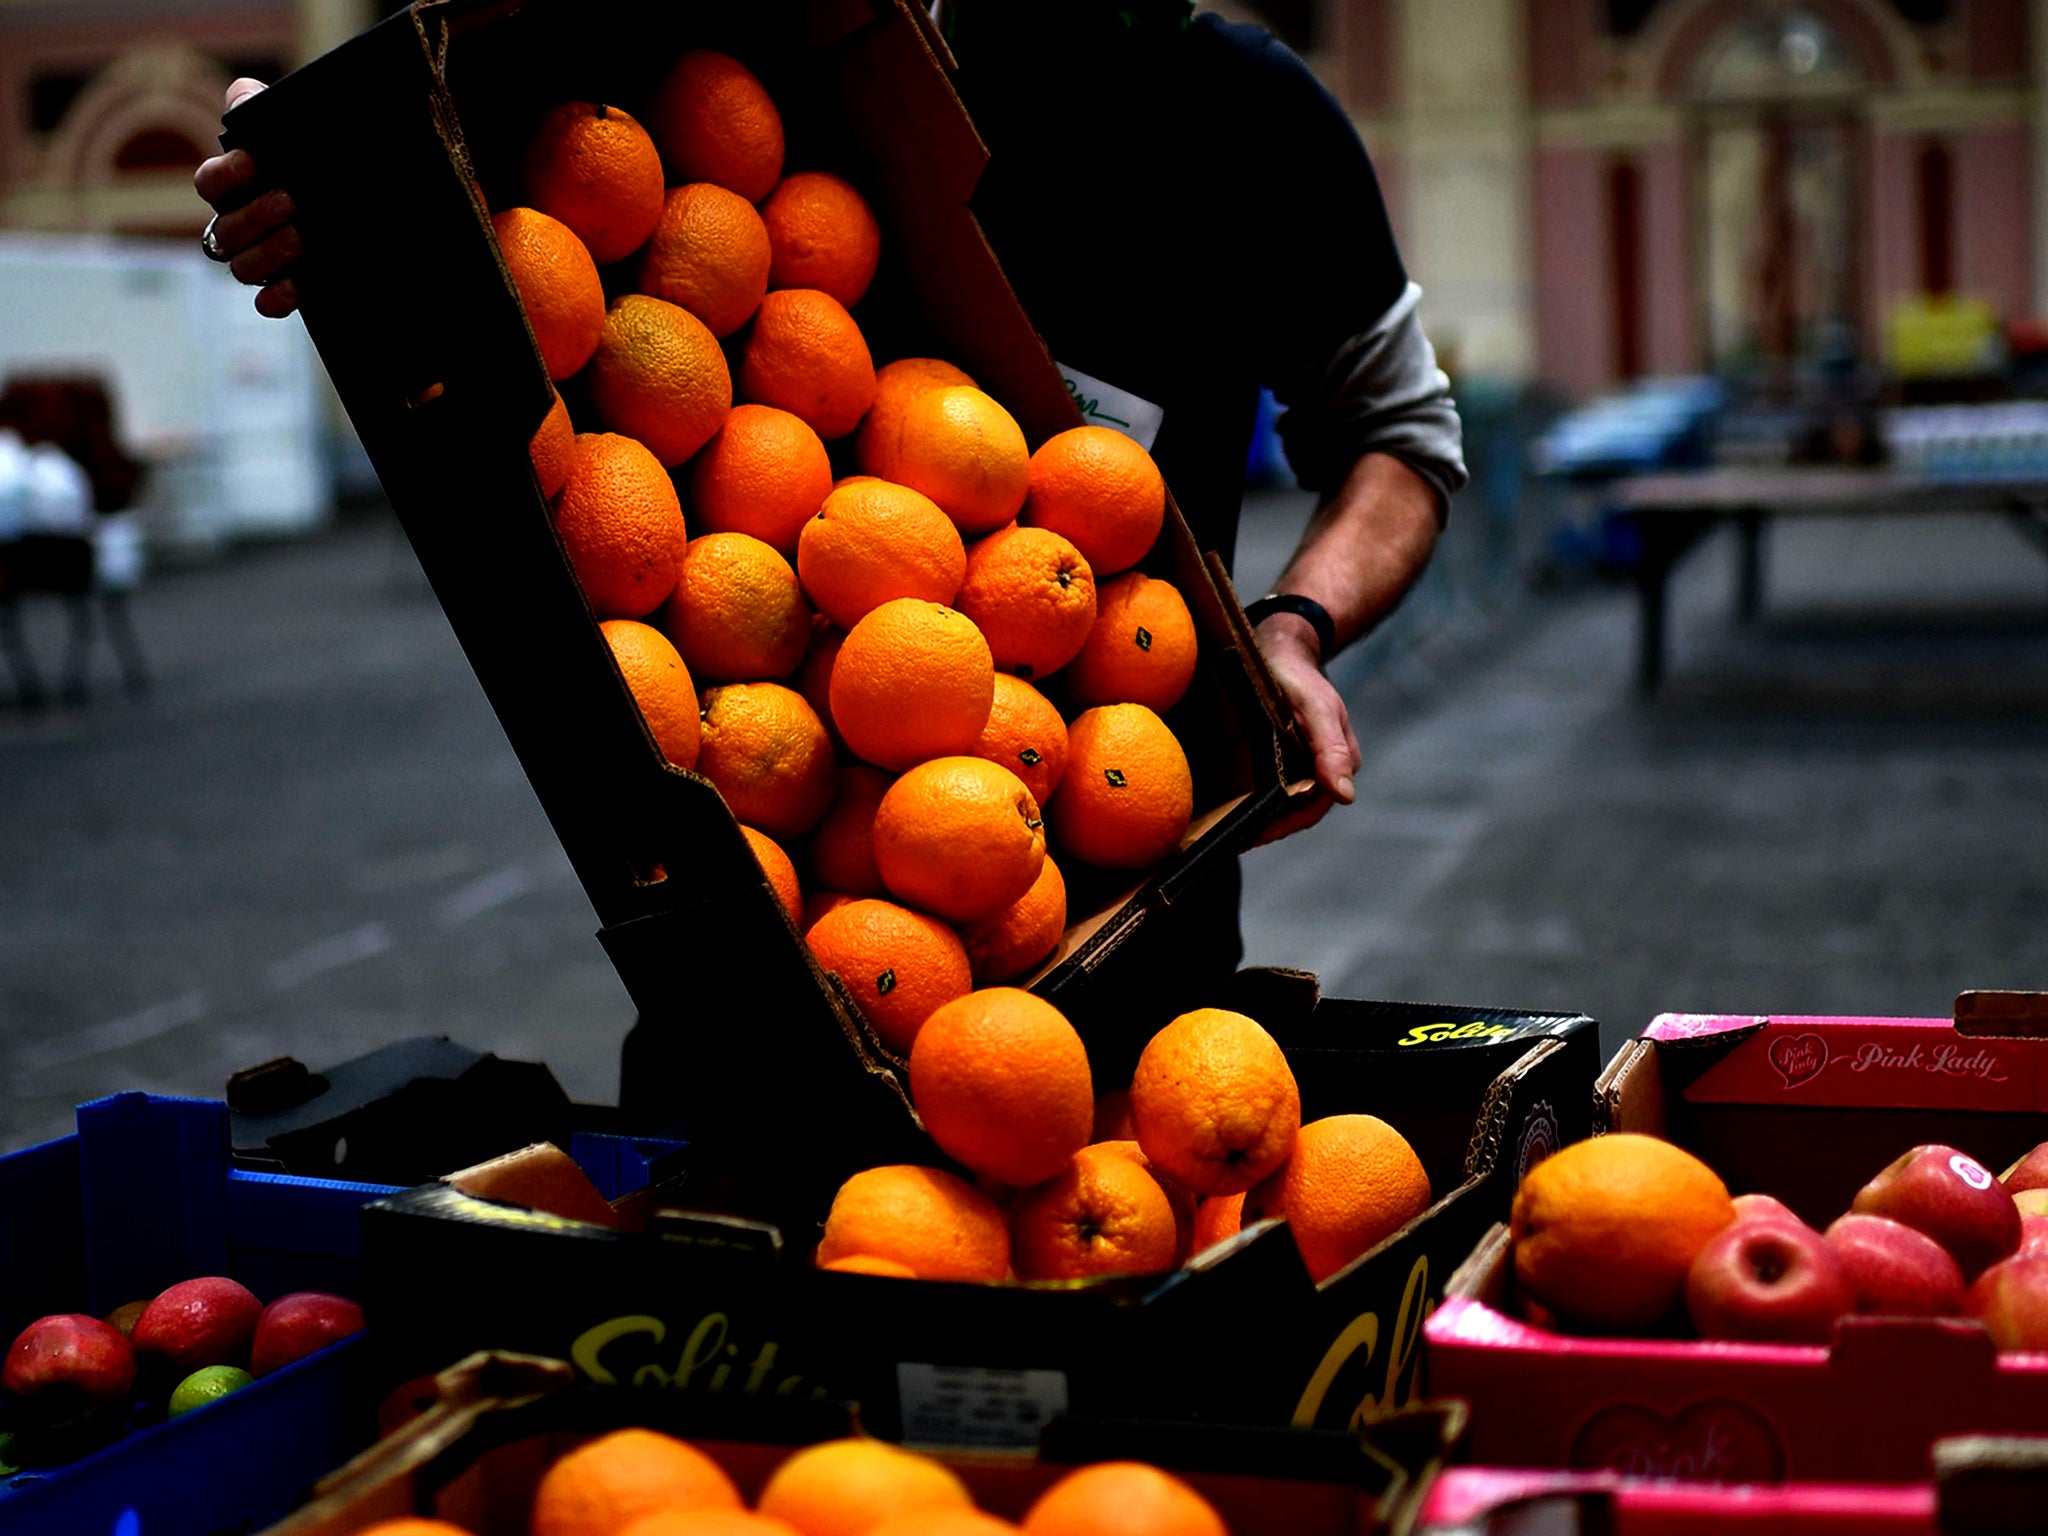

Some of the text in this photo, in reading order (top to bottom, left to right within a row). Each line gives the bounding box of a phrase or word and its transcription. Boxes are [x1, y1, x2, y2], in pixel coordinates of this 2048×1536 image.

[1779, 1041, 1813, 1066] Pink
[1832, 1042, 2008, 1082] Pink Lady
